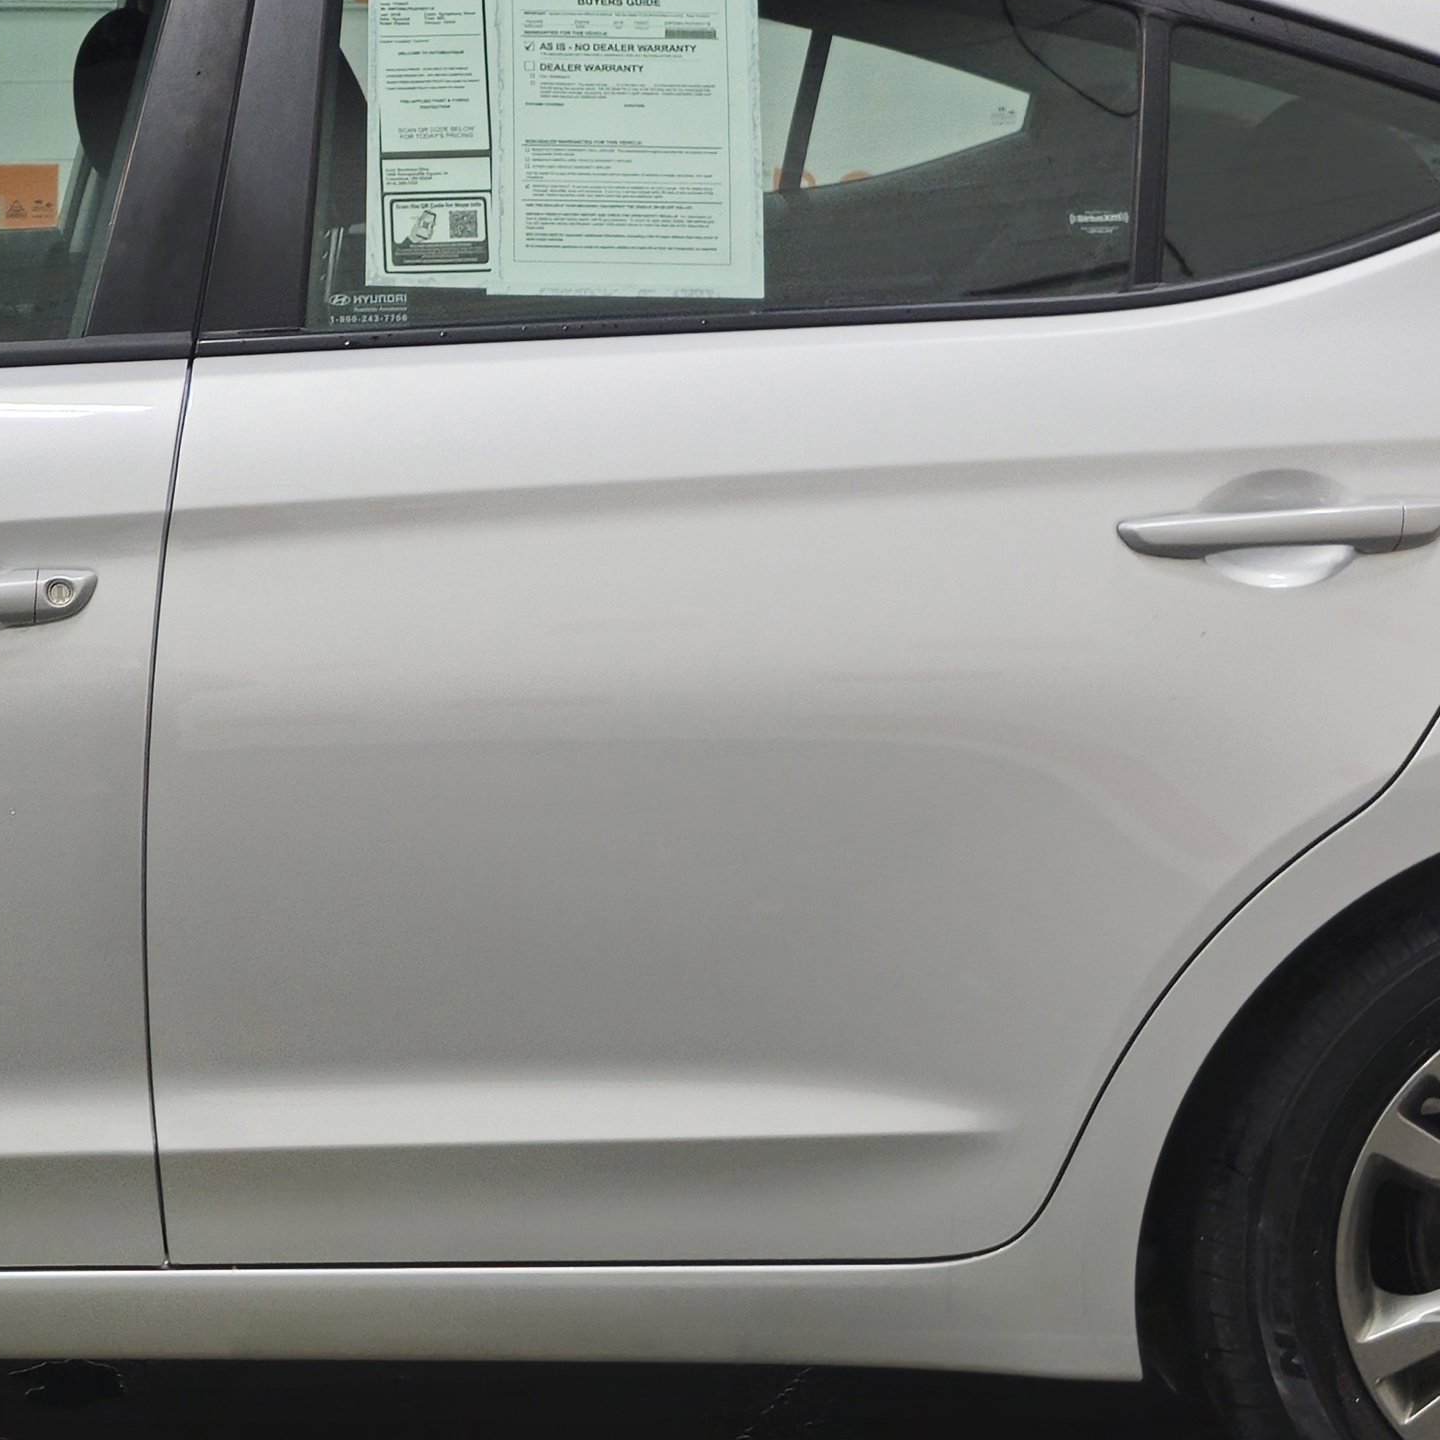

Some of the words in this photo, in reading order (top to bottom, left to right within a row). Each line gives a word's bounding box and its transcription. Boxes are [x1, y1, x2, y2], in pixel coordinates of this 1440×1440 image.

[539, 42, 553, 51] AS
[556, 43, 566, 51] IS
[575, 43, 590, 52] NO
[593, 44, 635, 52] DEALER
[637, 44, 697, 53] WARRANTY
[539, 63, 581, 72] DEALER
[584, 64, 644, 73] WARRANTY
